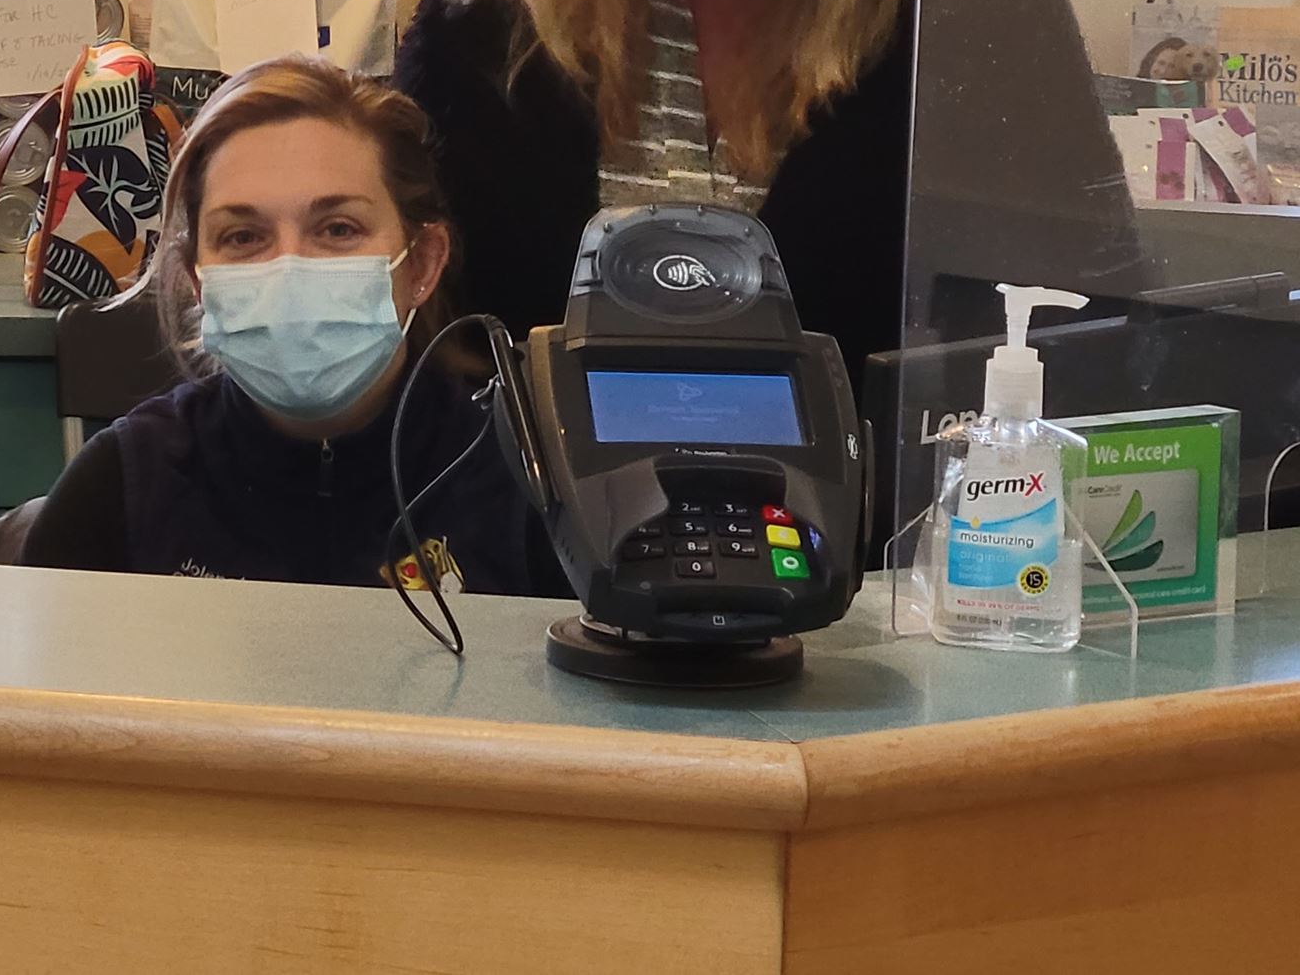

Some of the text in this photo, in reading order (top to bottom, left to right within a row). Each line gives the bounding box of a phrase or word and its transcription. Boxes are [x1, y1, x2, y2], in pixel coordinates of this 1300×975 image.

[172, 76, 211, 100] Mu
[1217, 81, 1297, 106] Kitchen
[1094, 442, 1180, 464] We Accept
[967, 473, 1044, 501] germ-X
[728, 524, 737, 532] 6
[687, 542, 696, 551] 8
[731, 542, 741, 552] 9
[959, 532, 1034, 548] moisturizing
[1029, 573, 1042, 586] 15
